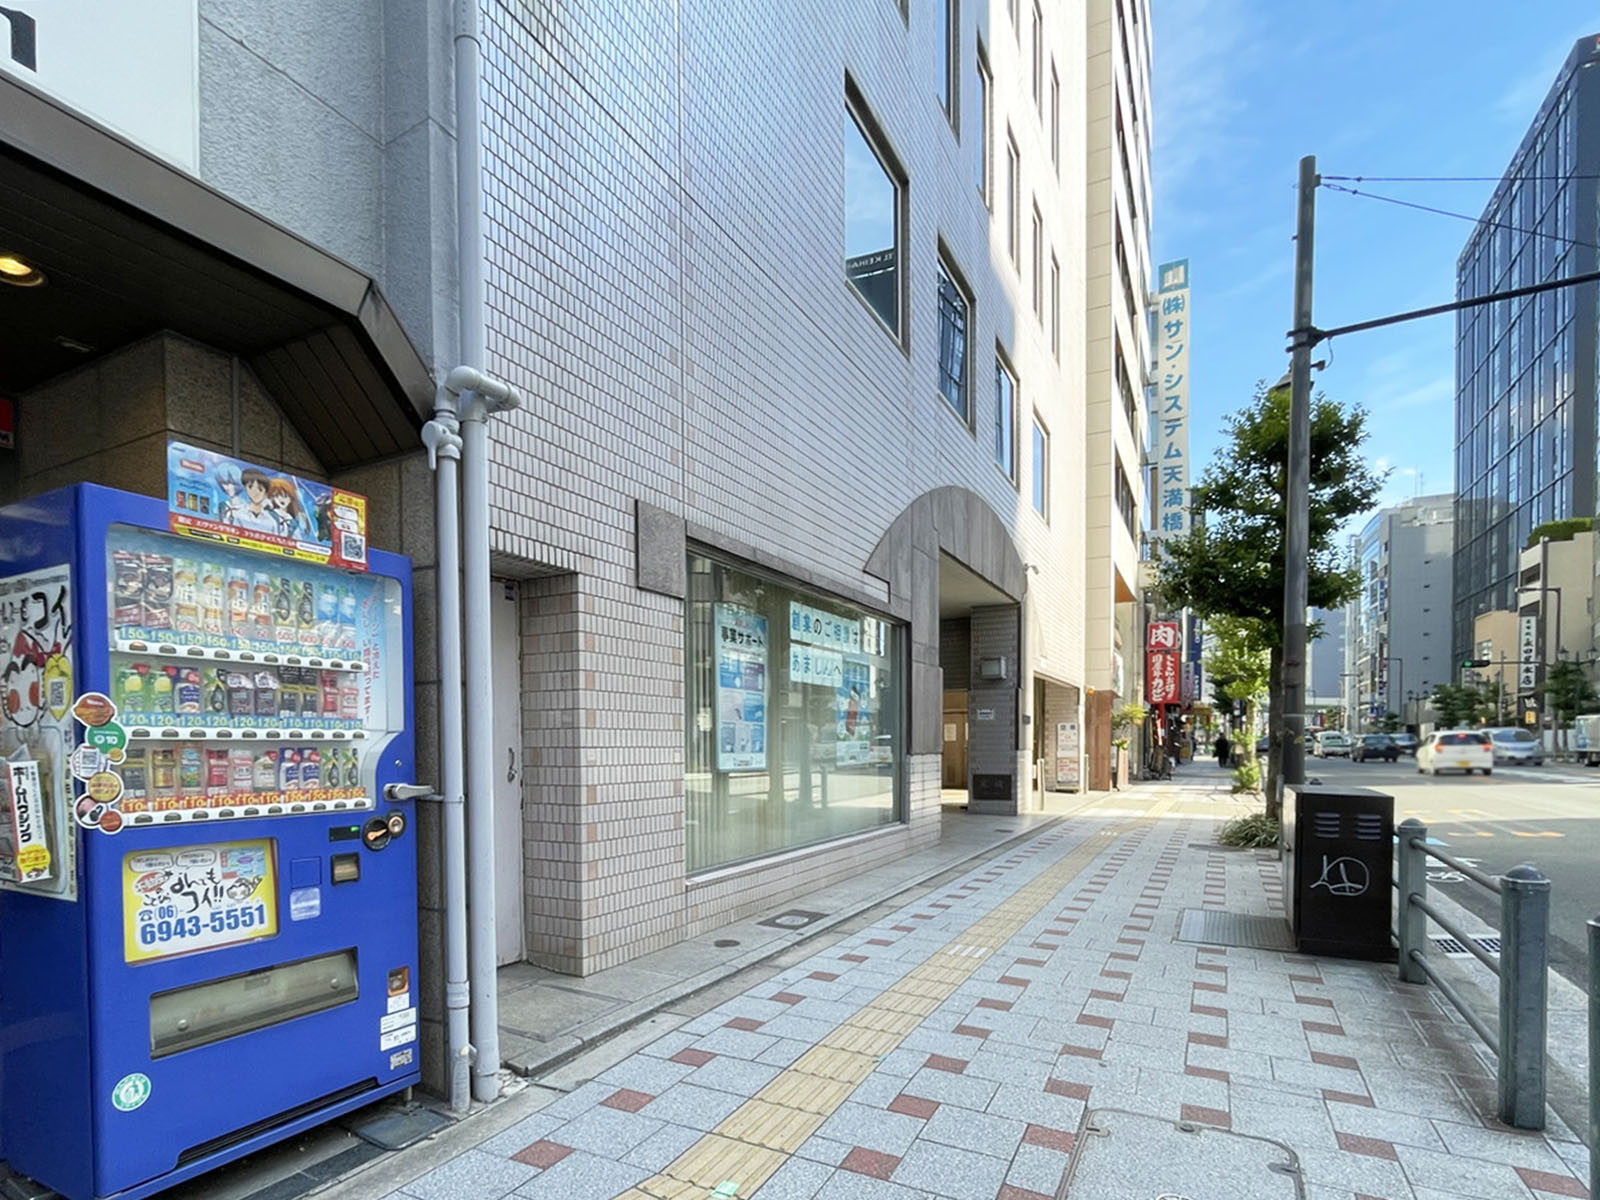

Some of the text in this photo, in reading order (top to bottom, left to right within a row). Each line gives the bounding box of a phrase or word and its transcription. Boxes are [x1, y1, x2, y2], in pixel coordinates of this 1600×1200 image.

[121, 628, 144, 639] 150
[151, 631, 172, 641] 150
[1151, 624, 1175, 647] 肉
[122, 714, 145, 725] 120
[151, 714, 172, 725] 120
[181, 715, 202, 726] 120
[206, 715, 227, 726] 120
[155, 905, 179, 920] (06)
[141, 904, 265, 945] 6943-5551
